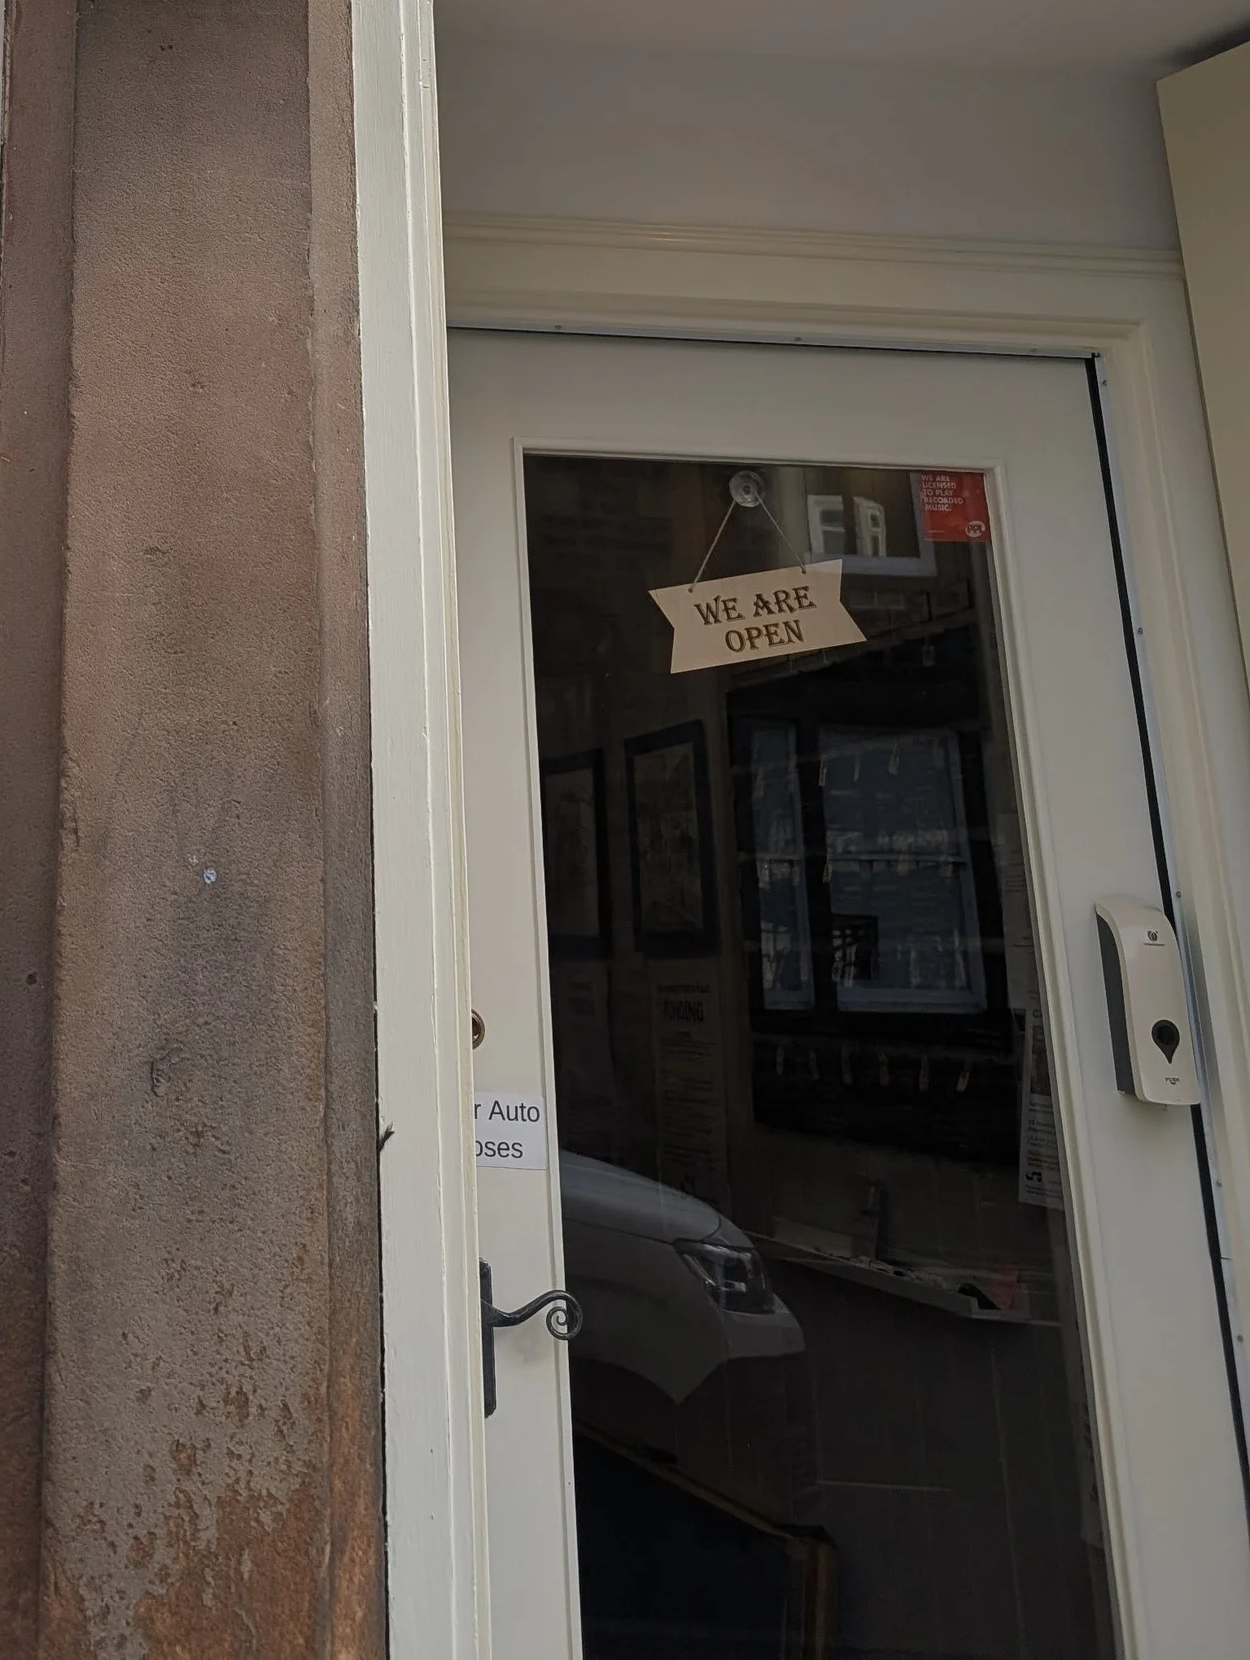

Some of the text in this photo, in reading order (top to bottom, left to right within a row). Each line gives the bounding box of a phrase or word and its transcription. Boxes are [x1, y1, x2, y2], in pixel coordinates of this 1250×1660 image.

[694, 585, 817, 626] WE ARE
[724, 619, 805, 653] OPEN
[488, 1100, 541, 1122] Auto
